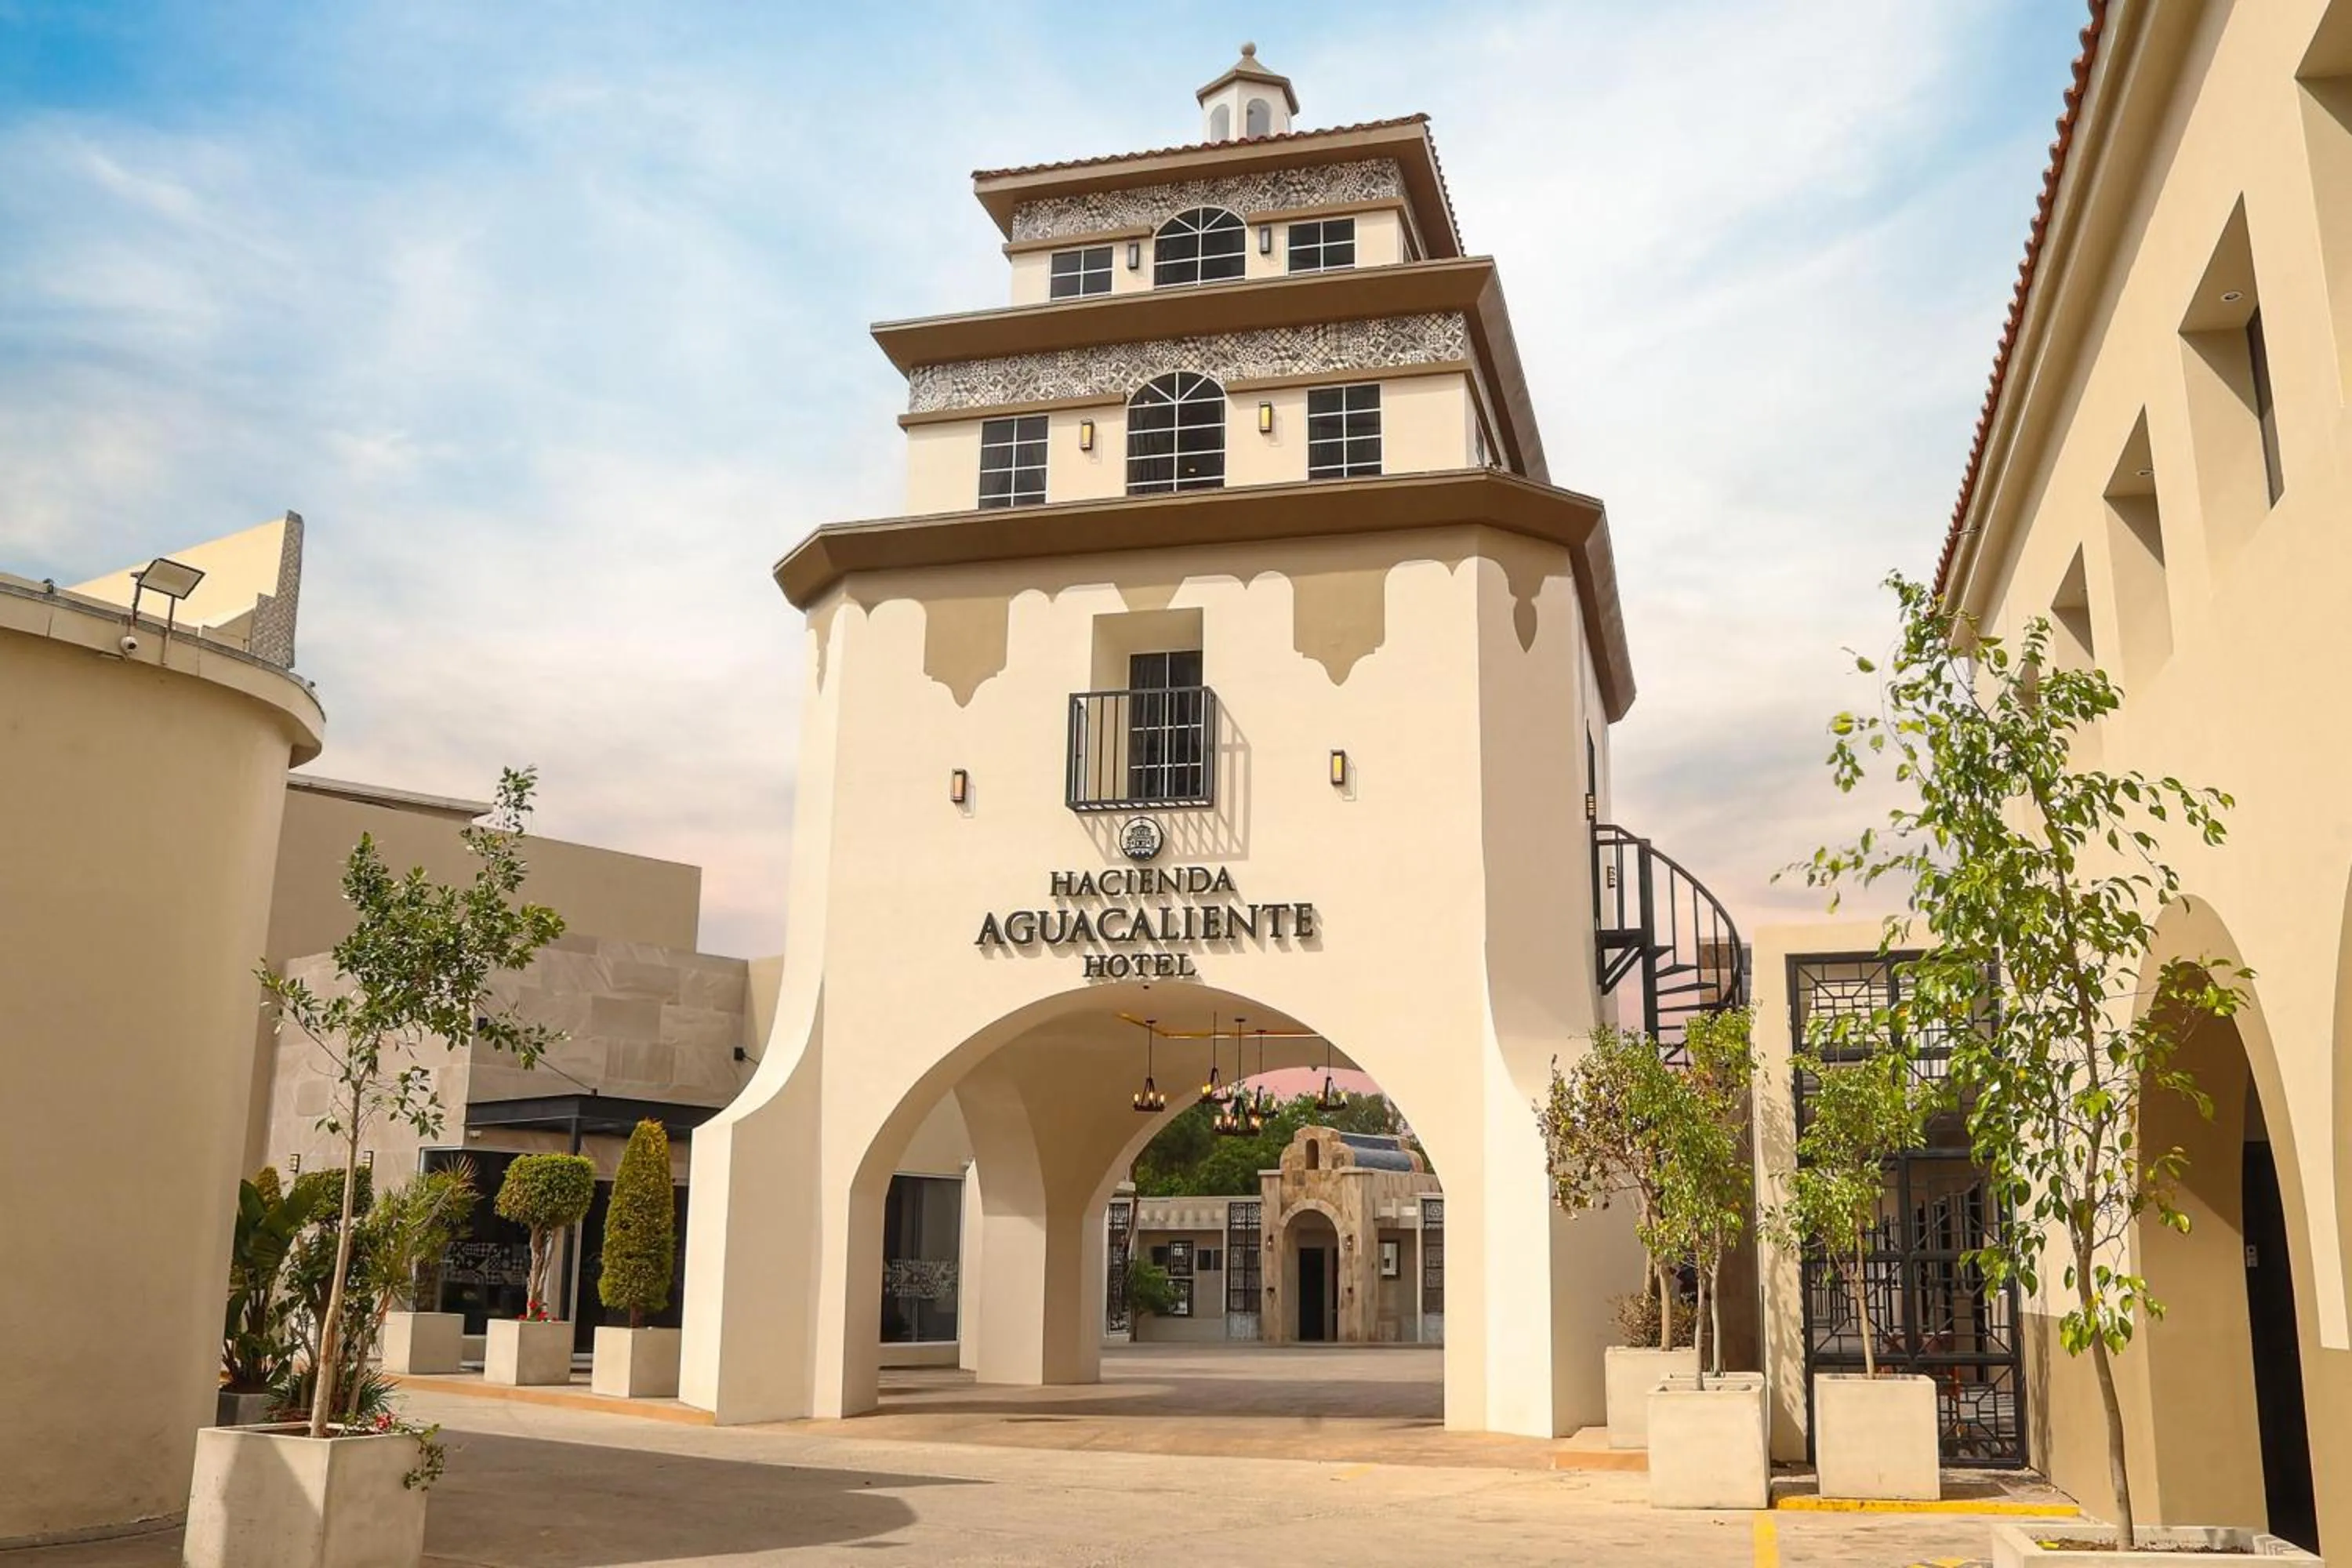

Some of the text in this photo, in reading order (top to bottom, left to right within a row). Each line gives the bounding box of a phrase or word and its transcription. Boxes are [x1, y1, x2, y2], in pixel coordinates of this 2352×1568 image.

[1050, 866, 1236, 897] HACIENDA
[974, 902, 1314, 946] AGUACALIENTE
[1082, 953, 1196, 978] HOTEL
